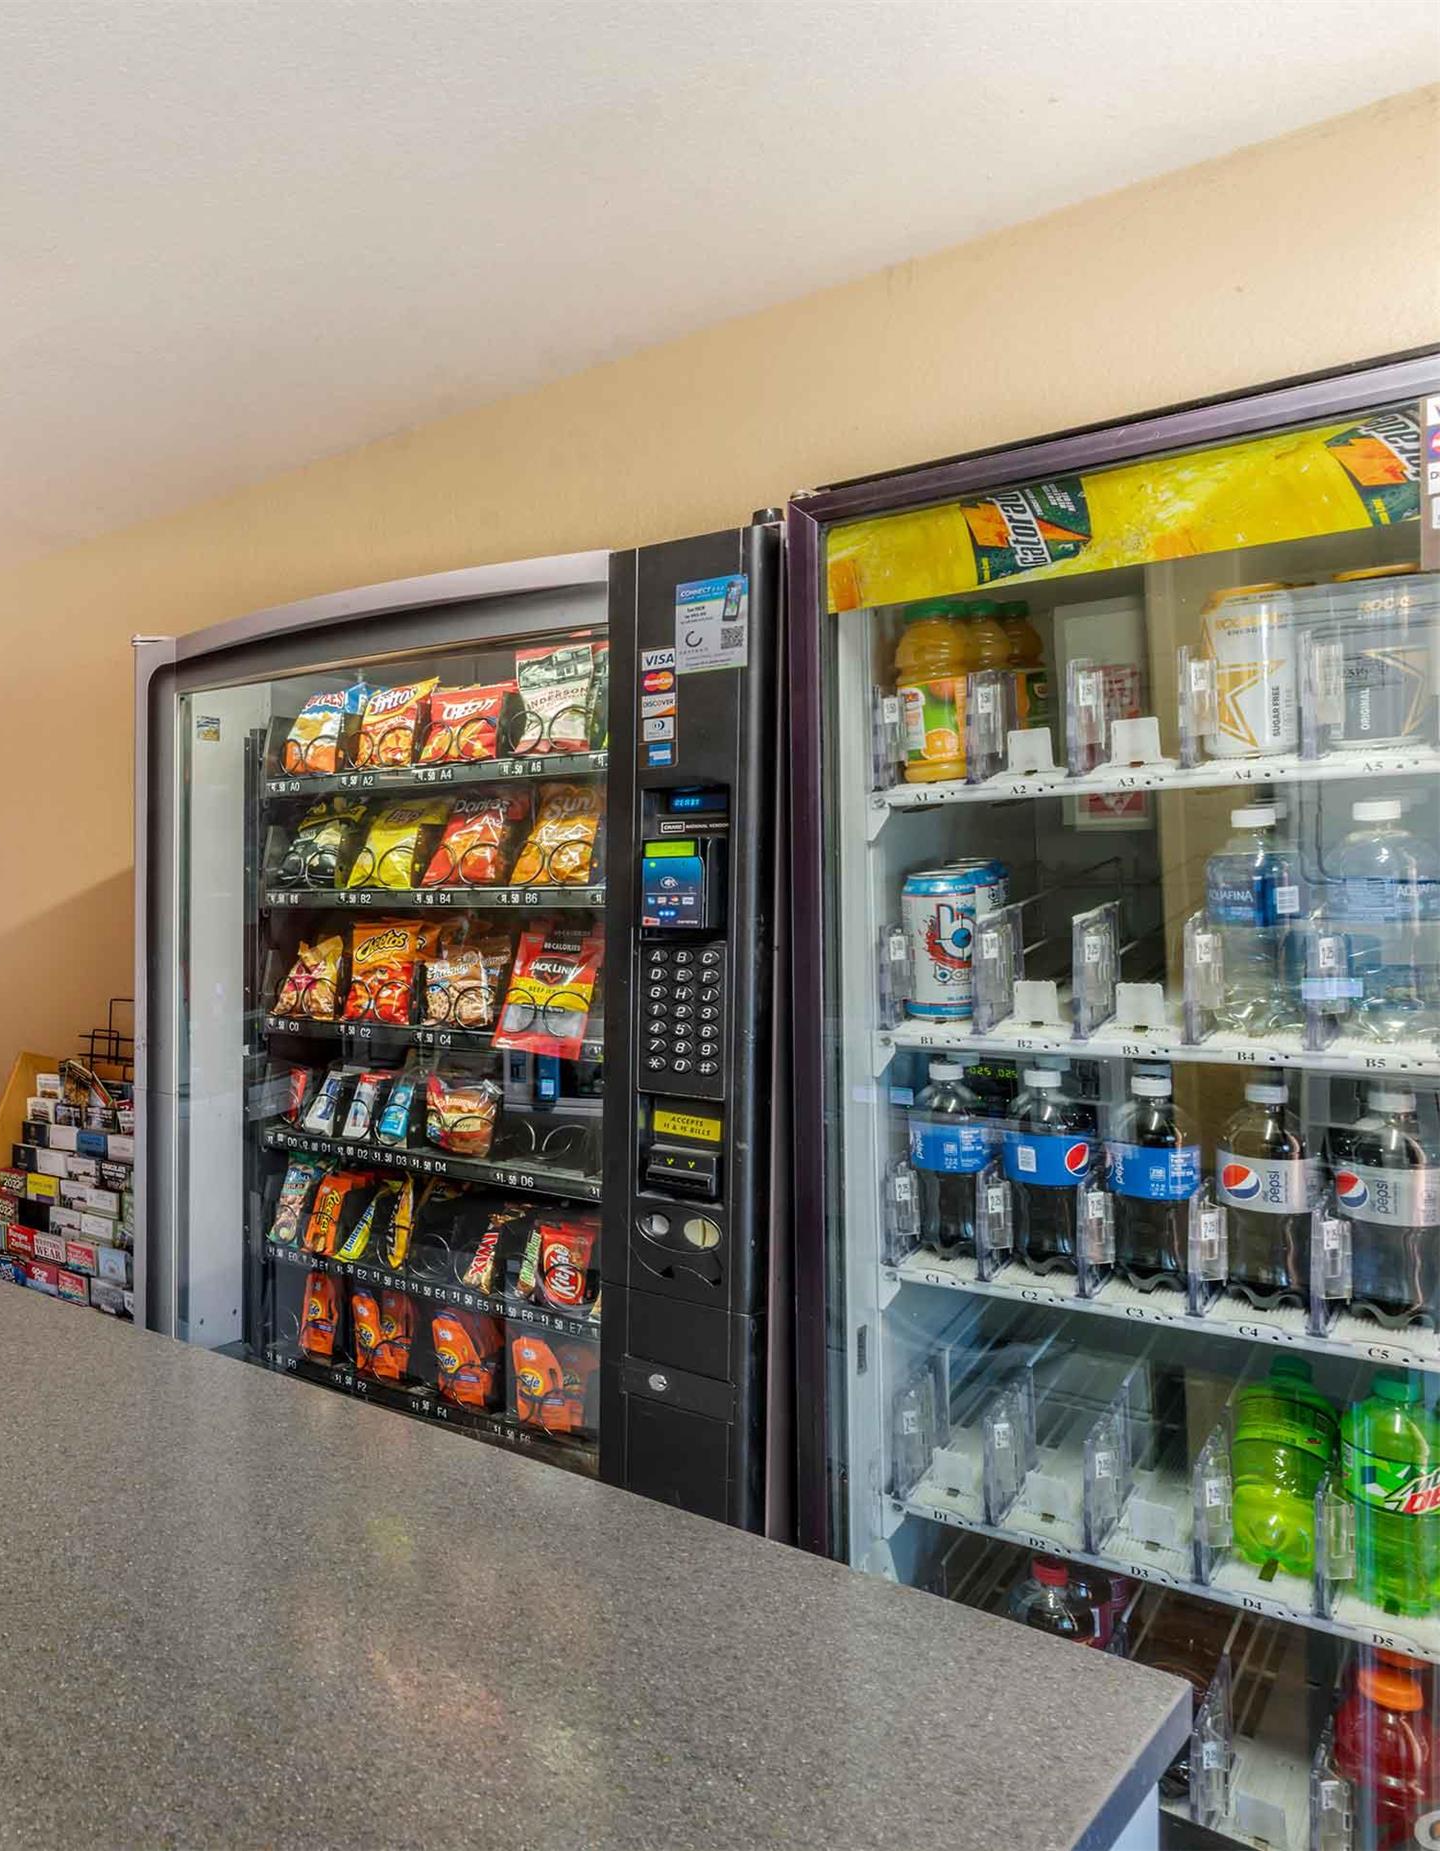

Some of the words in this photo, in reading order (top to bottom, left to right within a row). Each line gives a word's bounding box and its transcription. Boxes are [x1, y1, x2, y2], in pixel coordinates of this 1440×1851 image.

[645, 653, 674, 666] VISA
[643, 699, 674, 708] DISCOVER
[531, 761, 542, 773] A6
[1362, 761, 1384, 772] A5
[440, 768, 453, 780] A4
[1232, 769, 1252, 780] A4
[363, 775, 374, 786] A2
[1117, 777, 1136, 787] A3
[1010, 784, 1027, 795] A2
[355, 929, 410, 962] Cheetos
[651, 951, 662, 961] A
[676, 952, 687, 963] B
[702, 952, 713, 963] C
[528, 960, 552, 973] JACK
[651, 969, 661, 979] D
[676, 970, 686, 981] E
[702, 971, 713, 983] F
[650, 987, 661, 998] G
[675, 988, 687, 999] H
[702, 990, 712, 1001] J
[651, 1005, 660, 1015] 1
[676, 1006, 686, 1017] 2
[701, 1007, 711, 1018] 3
[360, 1027, 372, 1039] C2
[650, 1022, 660, 1033] 4
[675, 1024, 685, 1035] 5
[702, 1026, 711, 1038] 6
[440, 1034, 452, 1046] C4
[650, 1040, 659, 1050] 7
[920, 1036, 935, 1046] B1
[1016, 1039, 1034, 1050] B2
[675, 1042, 686, 1053] 8
[701, 1044, 711, 1055] 9
[1122, 1045, 1141, 1056] B3
[1236, 1051, 1256, 1062] B4
[675, 1060, 686, 1071] 0
[1365, 1058, 1387, 1069] B5
[671, 1115, 705, 1127] ACCEPTS
[689, 1126, 712, 1137] BILLS
[358, 1149, 368, 1160] D2
[396, 1154, 407, 1166] D3
[435, 1160, 447, 1173] D4
[521, 1175, 534, 1188] D6
[1268, 1170, 1280, 1204] pepsi
[1376, 1178, 1389, 1215] pepsi
[357, 1269, 367, 1280] E2
[395, 1280, 406, 1291] E3
[435, 1288, 446, 1300] E4
[1021, 1290, 1039, 1301] C2
[477, 1299, 489, 1312] E5
[521, 1309, 534, 1321] E6
[1126, 1306, 1145, 1318] C3
[569, 1319, 583, 1332] E7
[1238, 1326, 1259, 1338] C4
[1367, 1347, 1391, 1360] C5
[357, 1381, 367, 1393] F2
[437, 1407, 448, 1419] F4
[933, 1509, 948, 1521] D1
[1029, 1537, 1046, 1550] D2
[1131, 1565, 1149, 1578] D3
[1242, 1598, 1263, 1611] D4
[1372, 1634, 1394, 1648] D5
